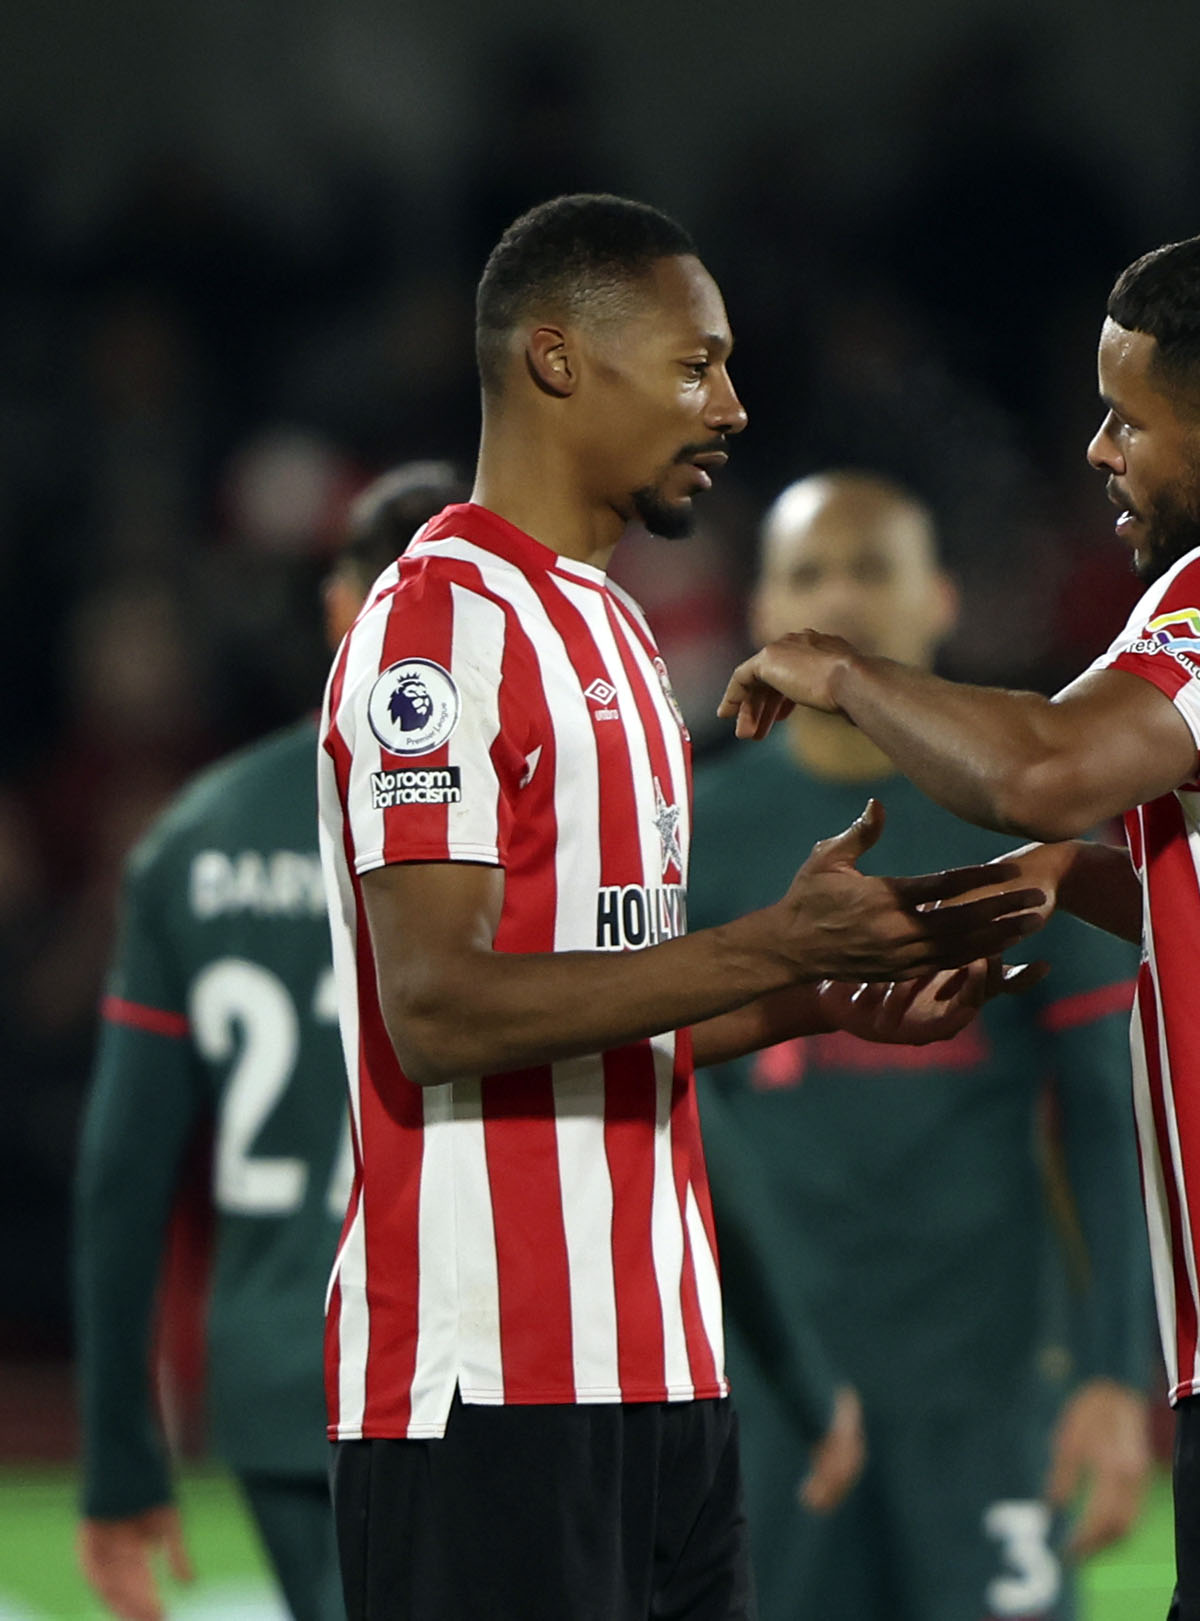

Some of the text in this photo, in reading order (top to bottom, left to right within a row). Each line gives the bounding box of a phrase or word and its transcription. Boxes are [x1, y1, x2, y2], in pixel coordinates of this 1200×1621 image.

[372, 771, 451, 791] No room
[374, 787, 460, 808] for racism
[596, 887, 688, 947] HOLLY
[984, 1501, 1060, 1612] 3
